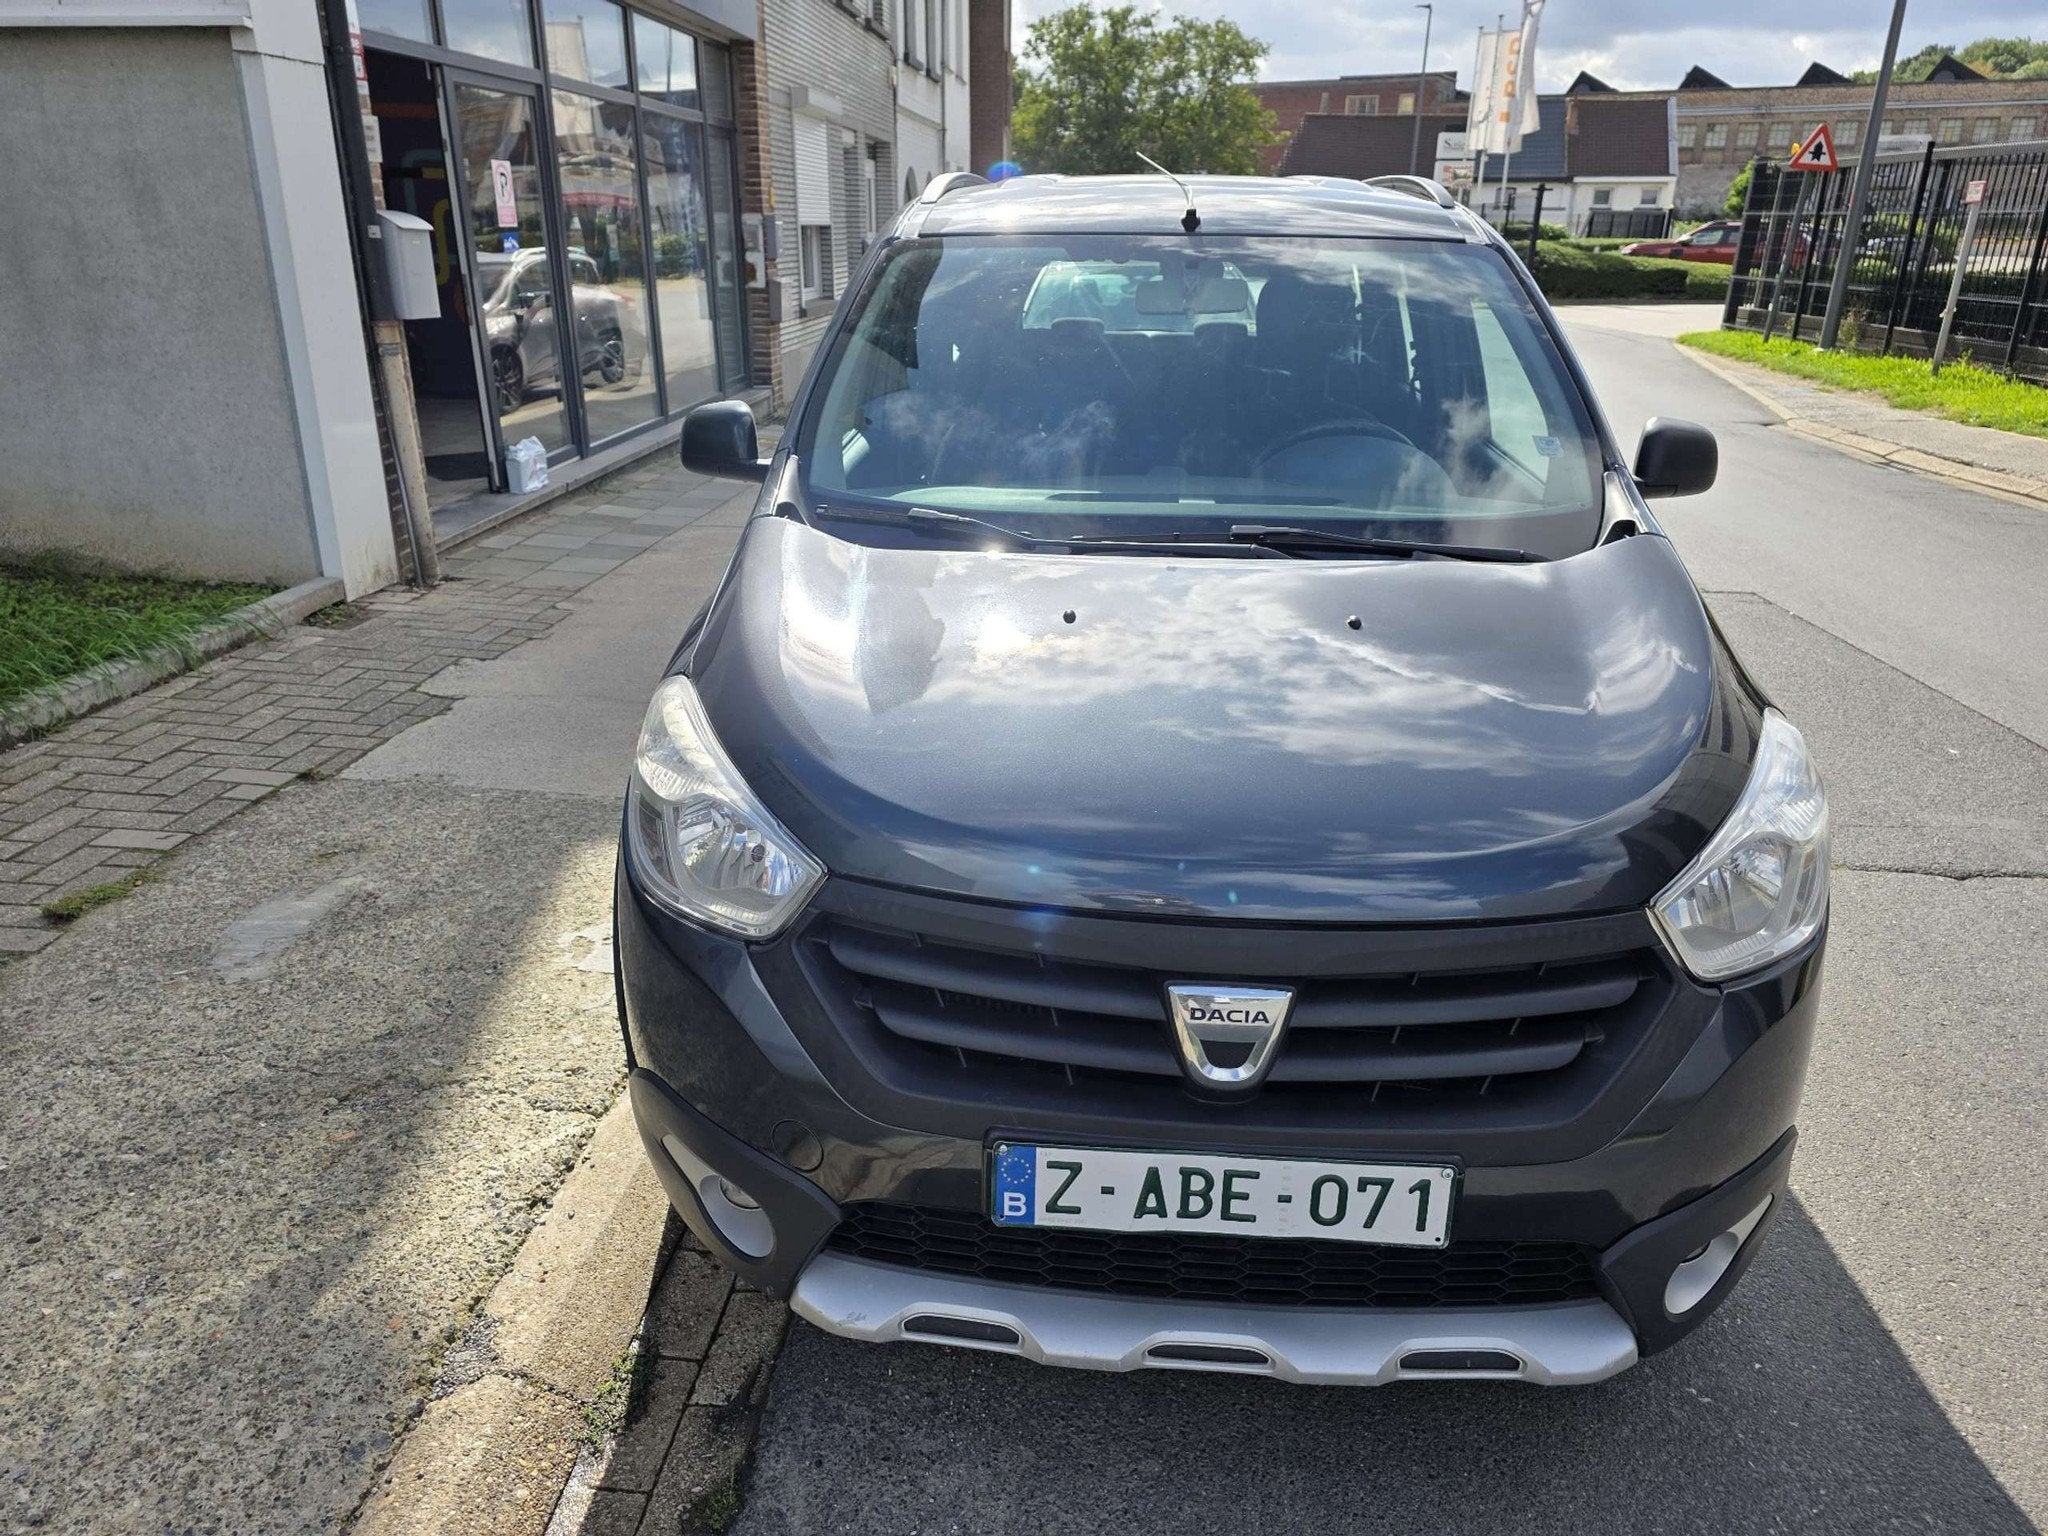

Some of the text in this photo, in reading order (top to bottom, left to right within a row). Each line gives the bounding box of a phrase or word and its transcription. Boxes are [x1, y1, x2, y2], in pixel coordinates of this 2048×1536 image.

[1190, 1007, 1270, 1024] DACIA
[1003, 1191, 1027, 1217] B
[1045, 1160, 1432, 1231] Z-ABE-071
